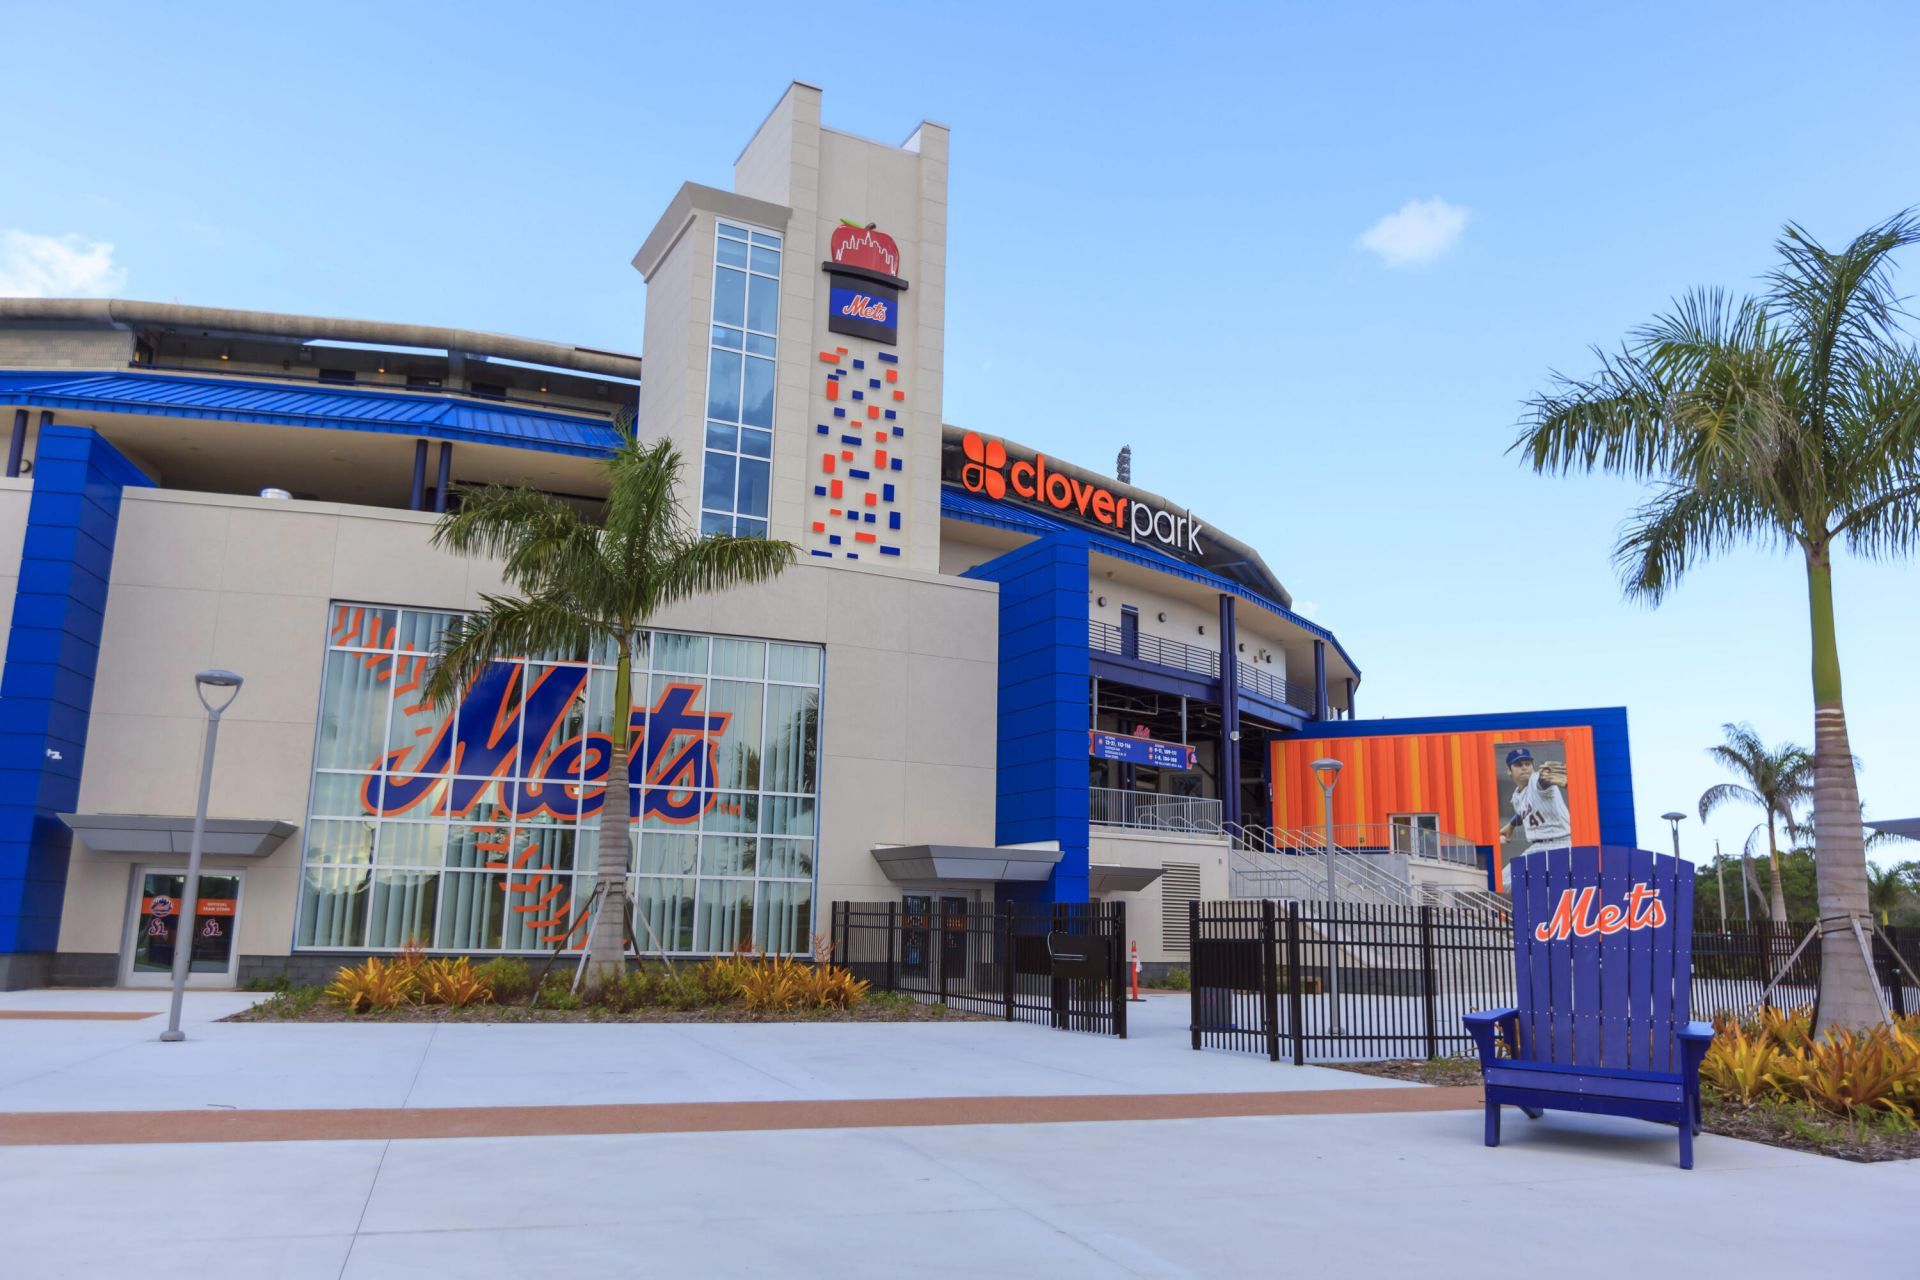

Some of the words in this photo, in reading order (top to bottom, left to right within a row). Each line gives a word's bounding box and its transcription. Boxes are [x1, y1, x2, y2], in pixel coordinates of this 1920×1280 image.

[842, 295, 888, 322] Mets
[1010, 453, 1128, 528] clover
[1131, 500, 1204, 555] park
[360, 656, 733, 825] Mets
[719, 803, 741, 816] TM
[1529, 810, 1546, 827] 41
[1535, 882, 1667, 942] Mets
